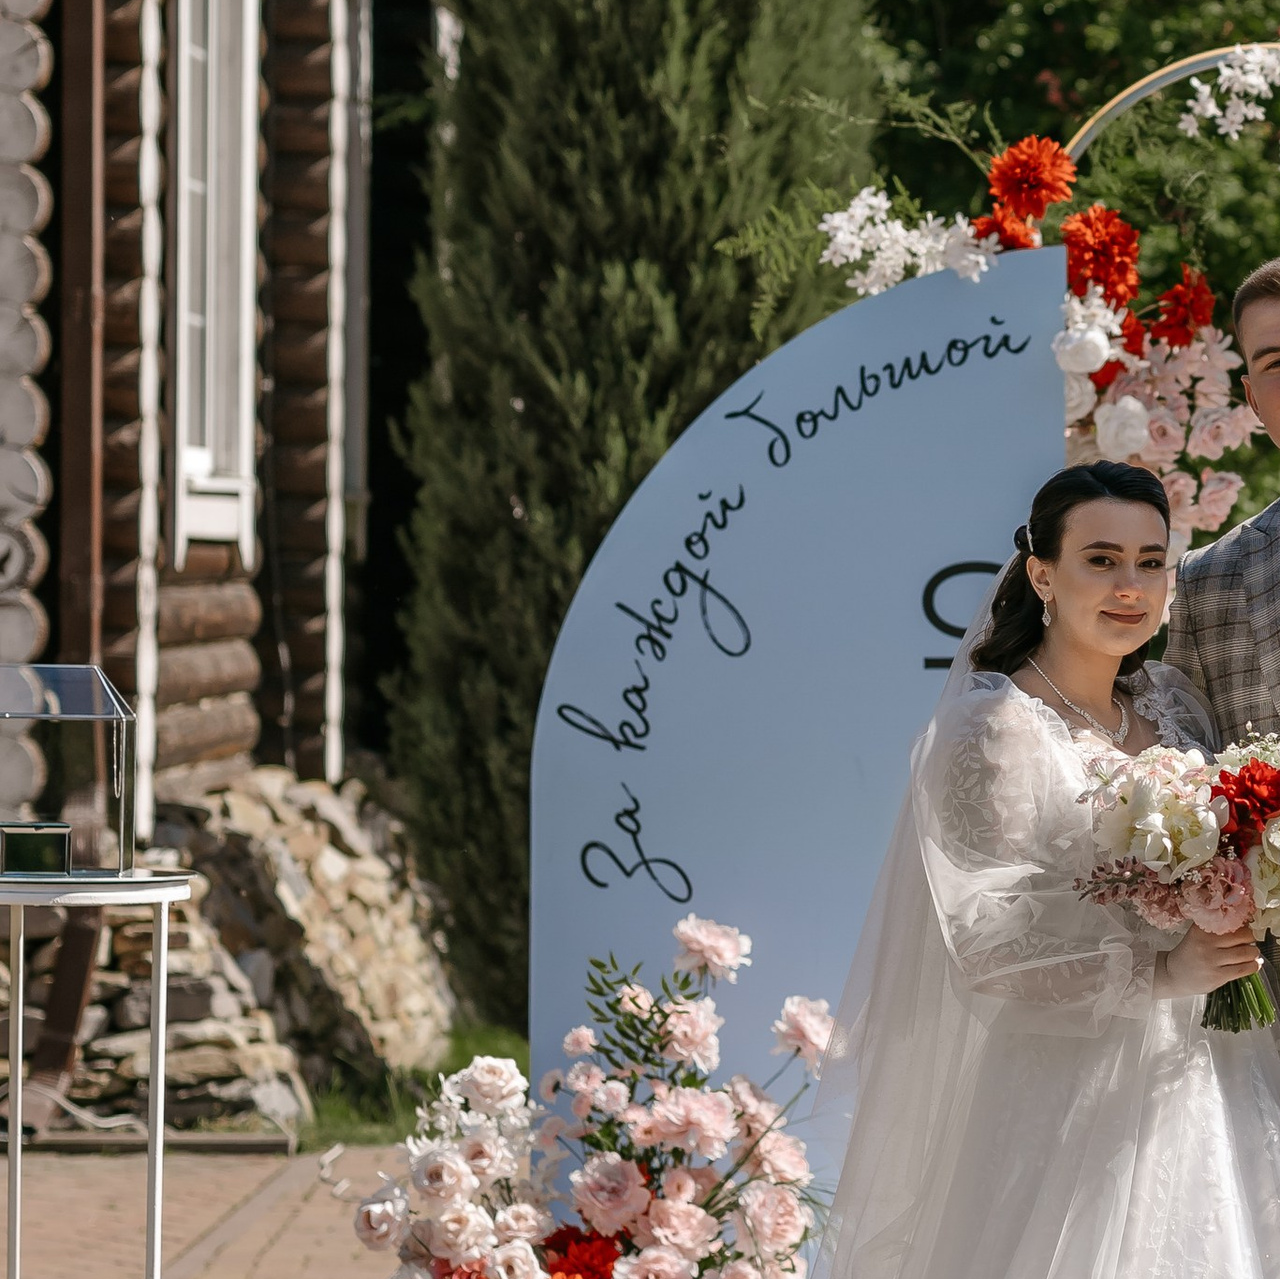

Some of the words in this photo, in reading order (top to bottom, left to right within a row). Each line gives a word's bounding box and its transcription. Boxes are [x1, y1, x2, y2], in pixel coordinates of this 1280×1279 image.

[724, 315, 1032, 468] большой
[556, 483, 752, 752] каждой
[579, 782, 693, 904] За
